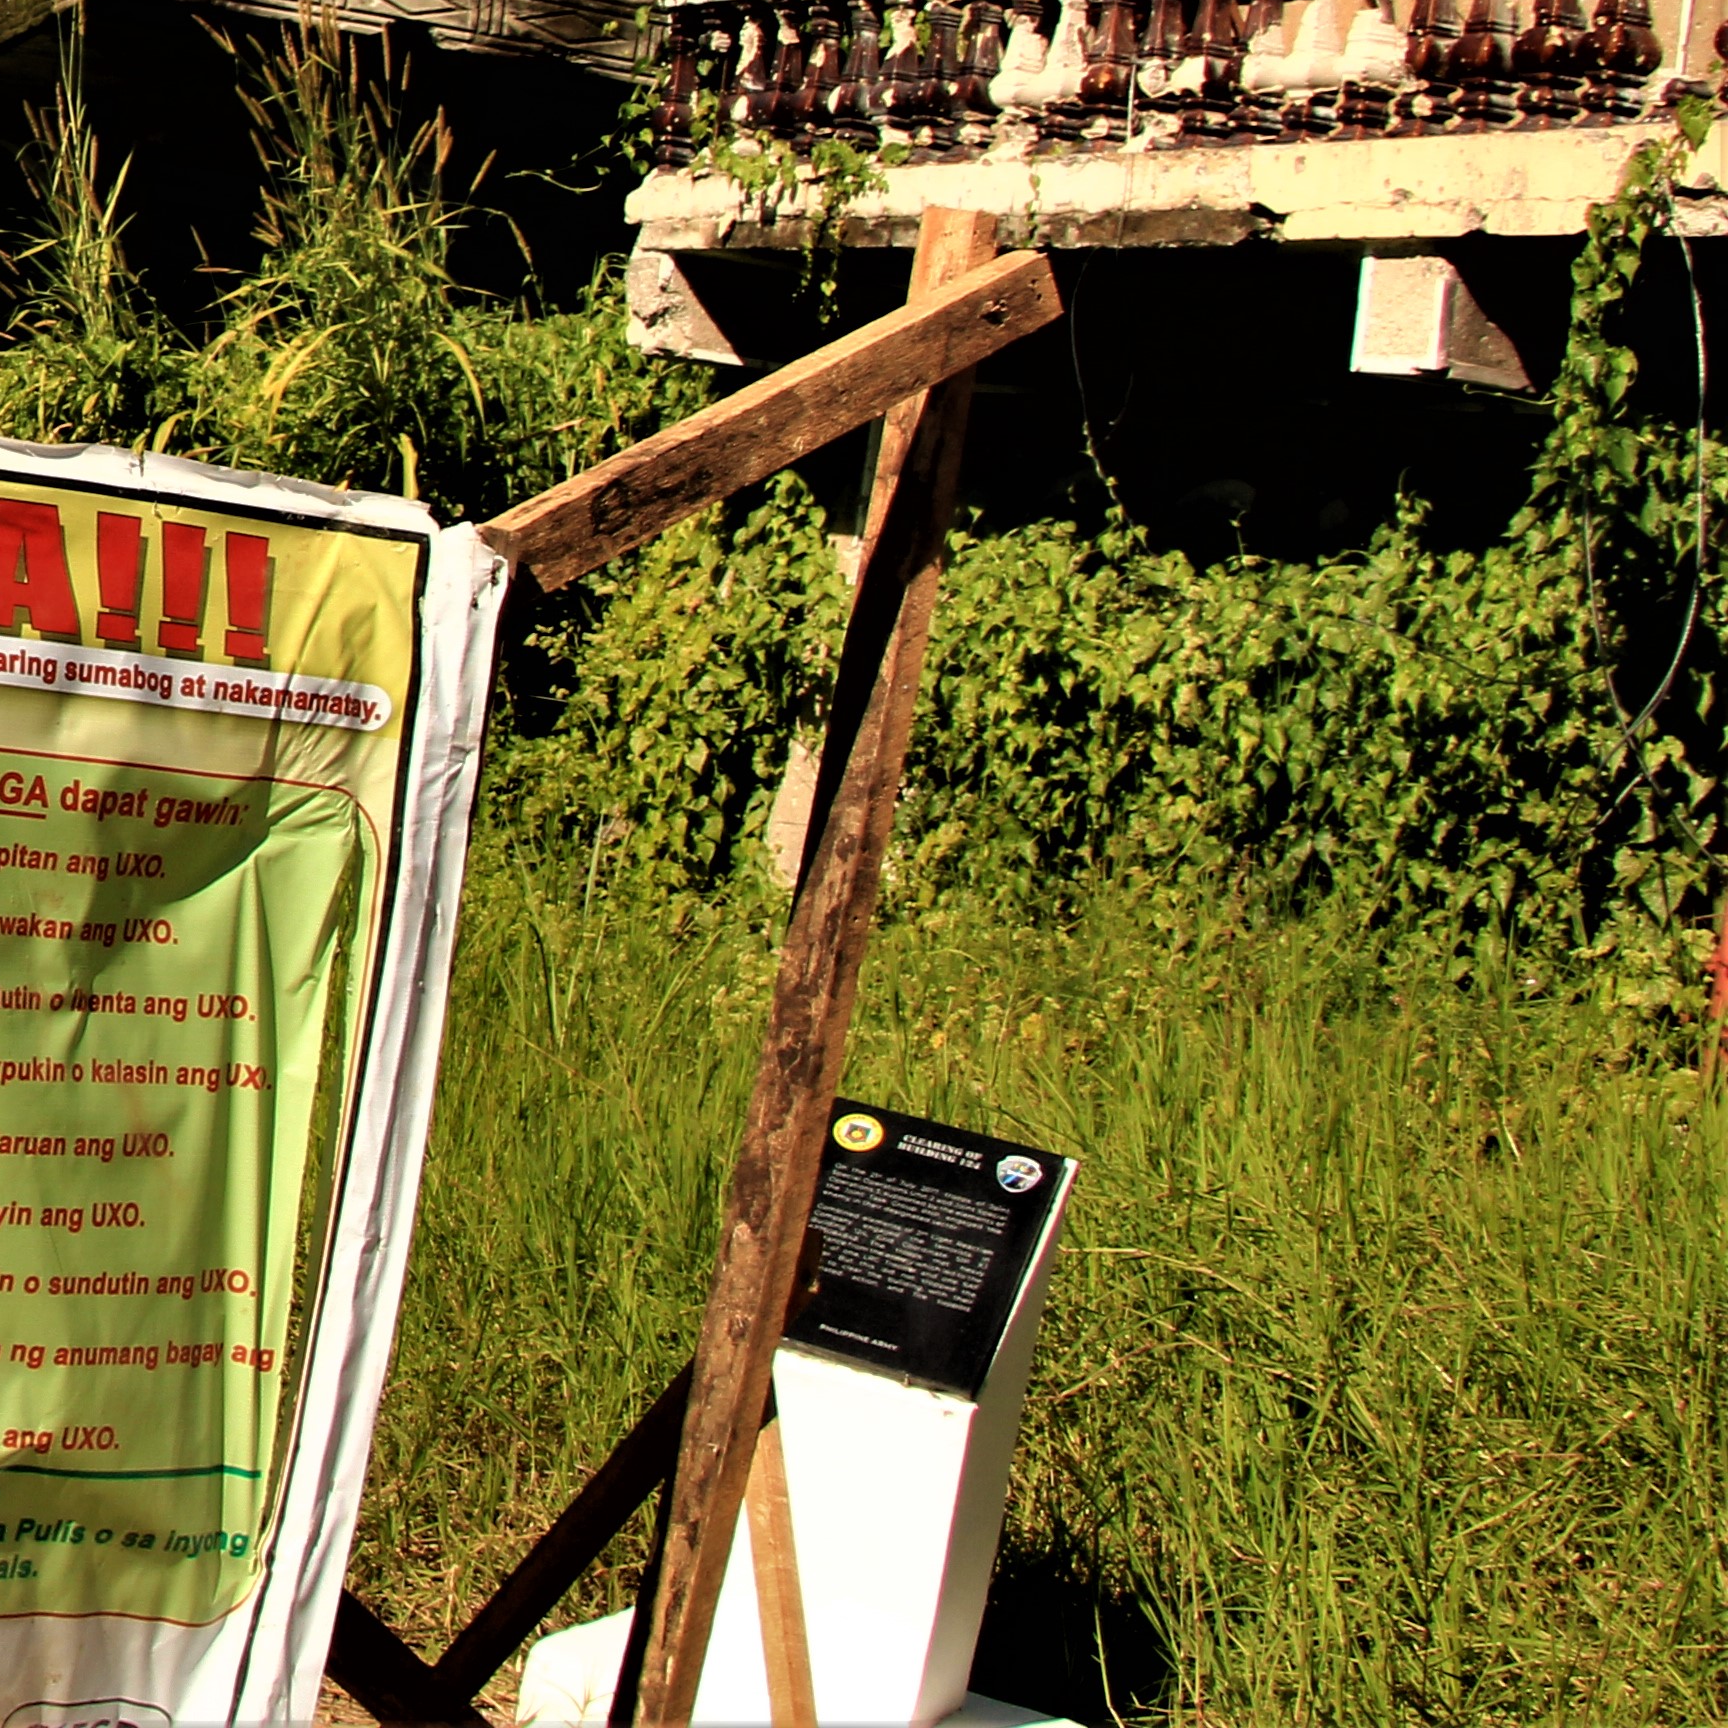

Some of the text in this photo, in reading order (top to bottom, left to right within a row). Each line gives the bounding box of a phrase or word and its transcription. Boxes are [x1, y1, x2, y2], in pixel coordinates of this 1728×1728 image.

[63, 659, 173, 698] sumabog
[179, 673, 207, 699] at
[213, 681, 383, 722] nakamamatay.
[59, 779, 149, 822] dapat
[153, 795, 249, 828] gawin:
[65, 854, 110, 881] ang
[115, 851, 166, 879] UXO.
[79, 920, 116, 947] ang
[122, 918, 180, 945] UXO.
[49, 993, 65, 1011] o
[143, 996, 188, 1023] ang
[196, 993, 257, 1022] UXO.
[71, 1063, 84, 1083] o
[91, 1059, 169, 1085] kalasin
[175, 1067, 221, 1093] ang
[73, 1136, 115, 1163] ang
[121, 1132, 175, 1159] UXO.
[896, 1140, 957, 1164] BUILDING
[902, 1134, 985, 1161] CLEARING OF
[39, 1207, 83, 1233] ang
[91, 1202, 146, 1229] UXO.
[23, 1275, 41, 1295] o
[47, 1268, 150, 1297] sundutin
[155, 1273, 194, 1301] ang
[199, 1268, 258, 1299] UXO.
[819, 1323, 871, 1345] PHILIPPINE
[10, 1342, 46, 1368] ng
[52, 1341, 159, 1370] anumang
[166, 1339, 224, 1368] bagay
[2, 1429, 52, 1454] ang
[60, 1426, 120, 1451] UXO.
[14, 1517, 84, 1545] Pulis
[94, 1528, 114, 1546] o
[121, 1530, 156, 1549] sa
[164, 1528, 250, 1558] inyong
